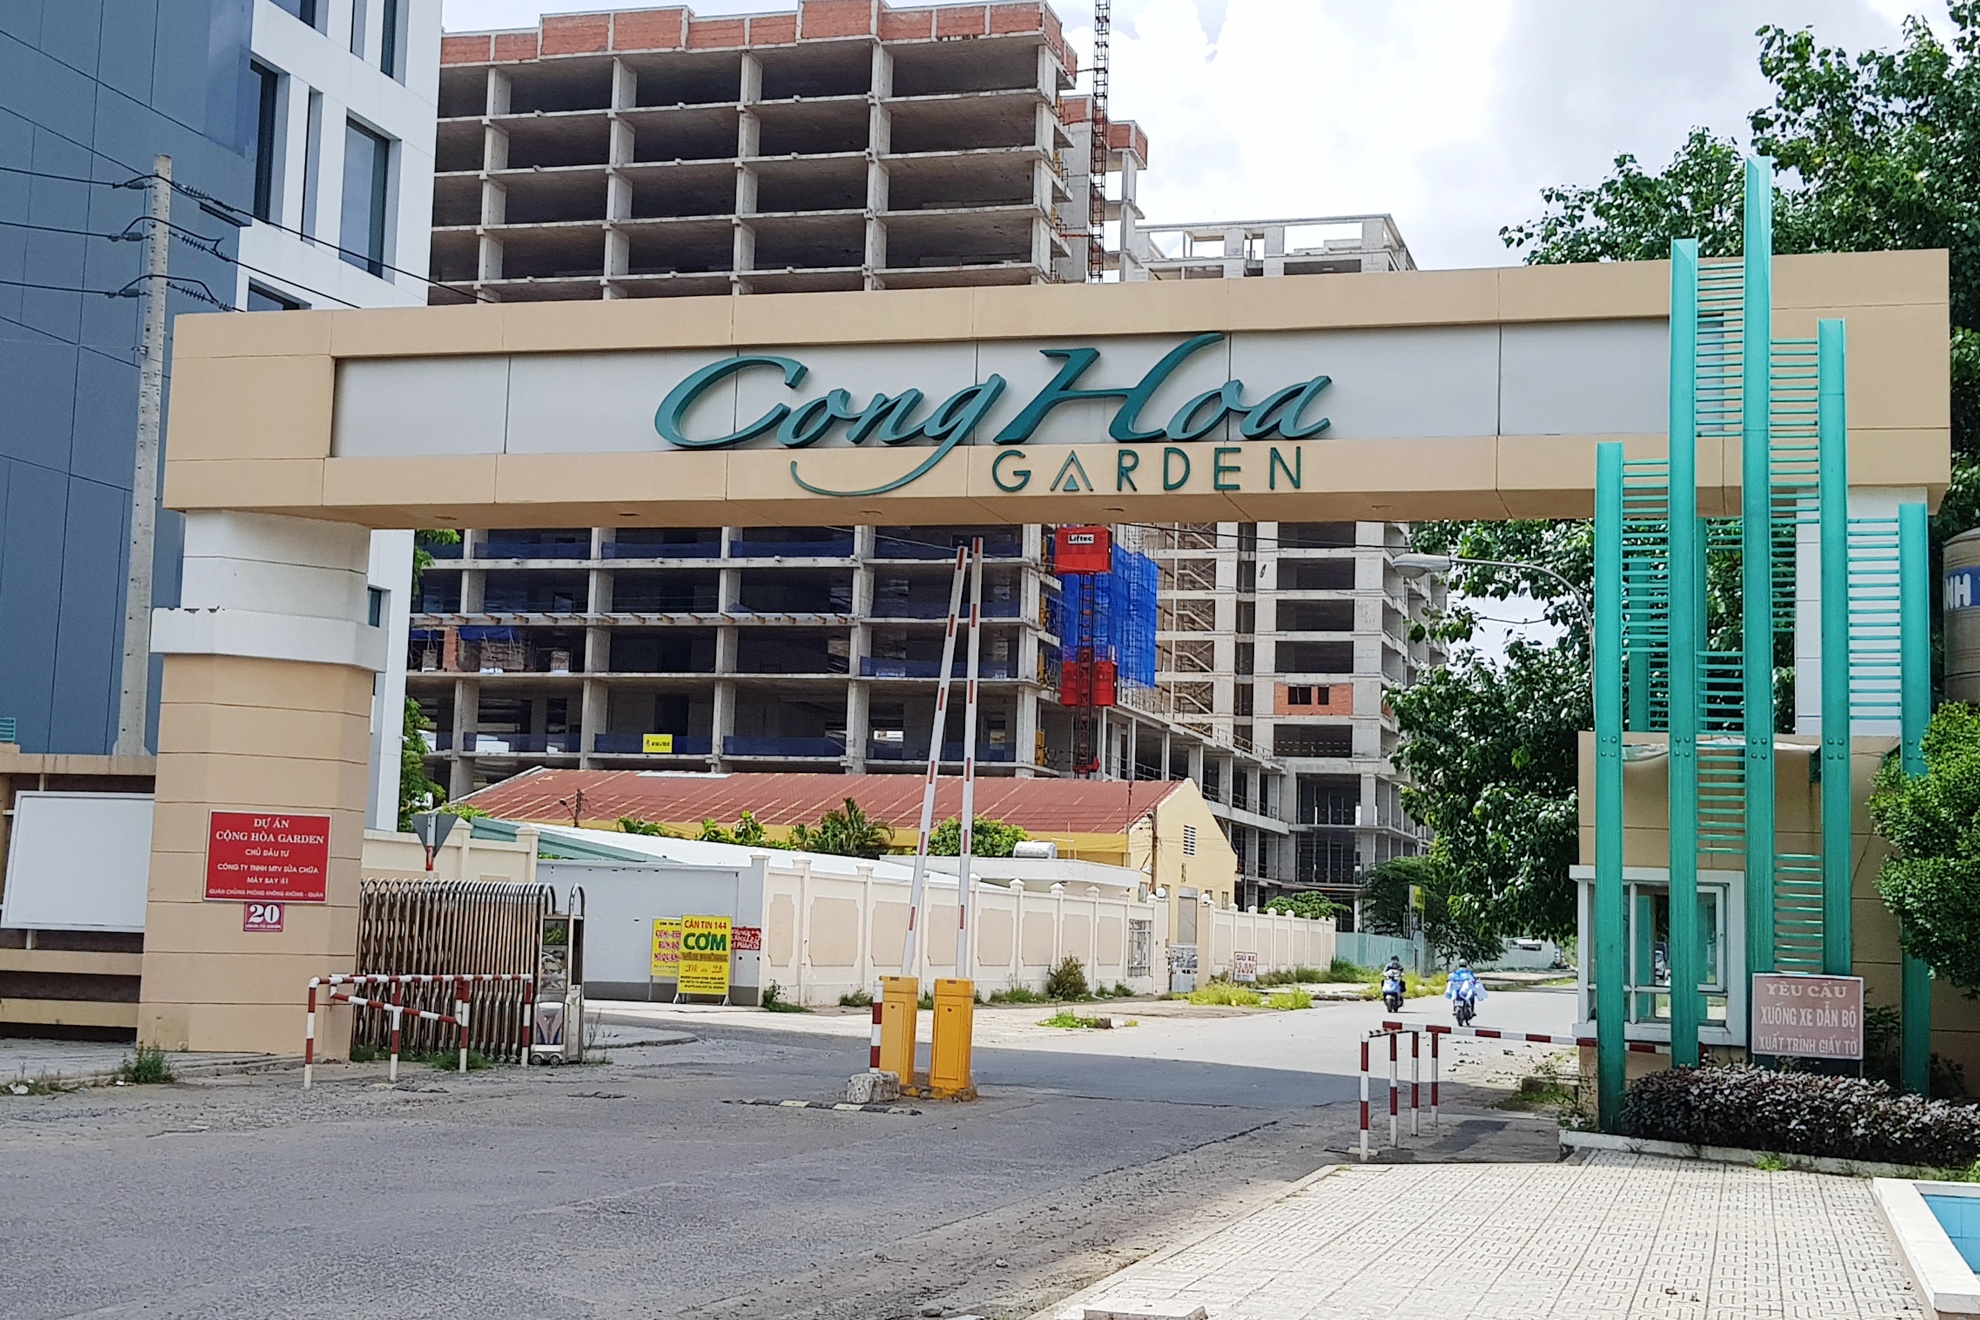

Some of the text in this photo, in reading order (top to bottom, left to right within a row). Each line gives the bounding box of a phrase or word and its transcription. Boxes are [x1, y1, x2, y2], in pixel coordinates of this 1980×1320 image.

[655, 332, 1332, 497] Cong Hoa
[991, 446, 1302, 492] GARDEN
[253, 817, 290, 829] DỰ ÁN
[215, 829, 325, 844] CỘNG HÒA GARDEN
[245, 847, 261, 856] CHỦ
[280, 849, 290, 857] TƯ
[217, 862, 239, 870] CÔNG
[248, 904, 280, 924] 20
[683, 931, 727, 951] CƠM
[1765, 981, 1847, 998] YÊU CẦU
[1760, 1001, 1857, 1032] XUỐNG XE DẪN BỘ
[1758, 1031, 1858, 1055] XUẤT TRÌNH GIẤY TỜ
